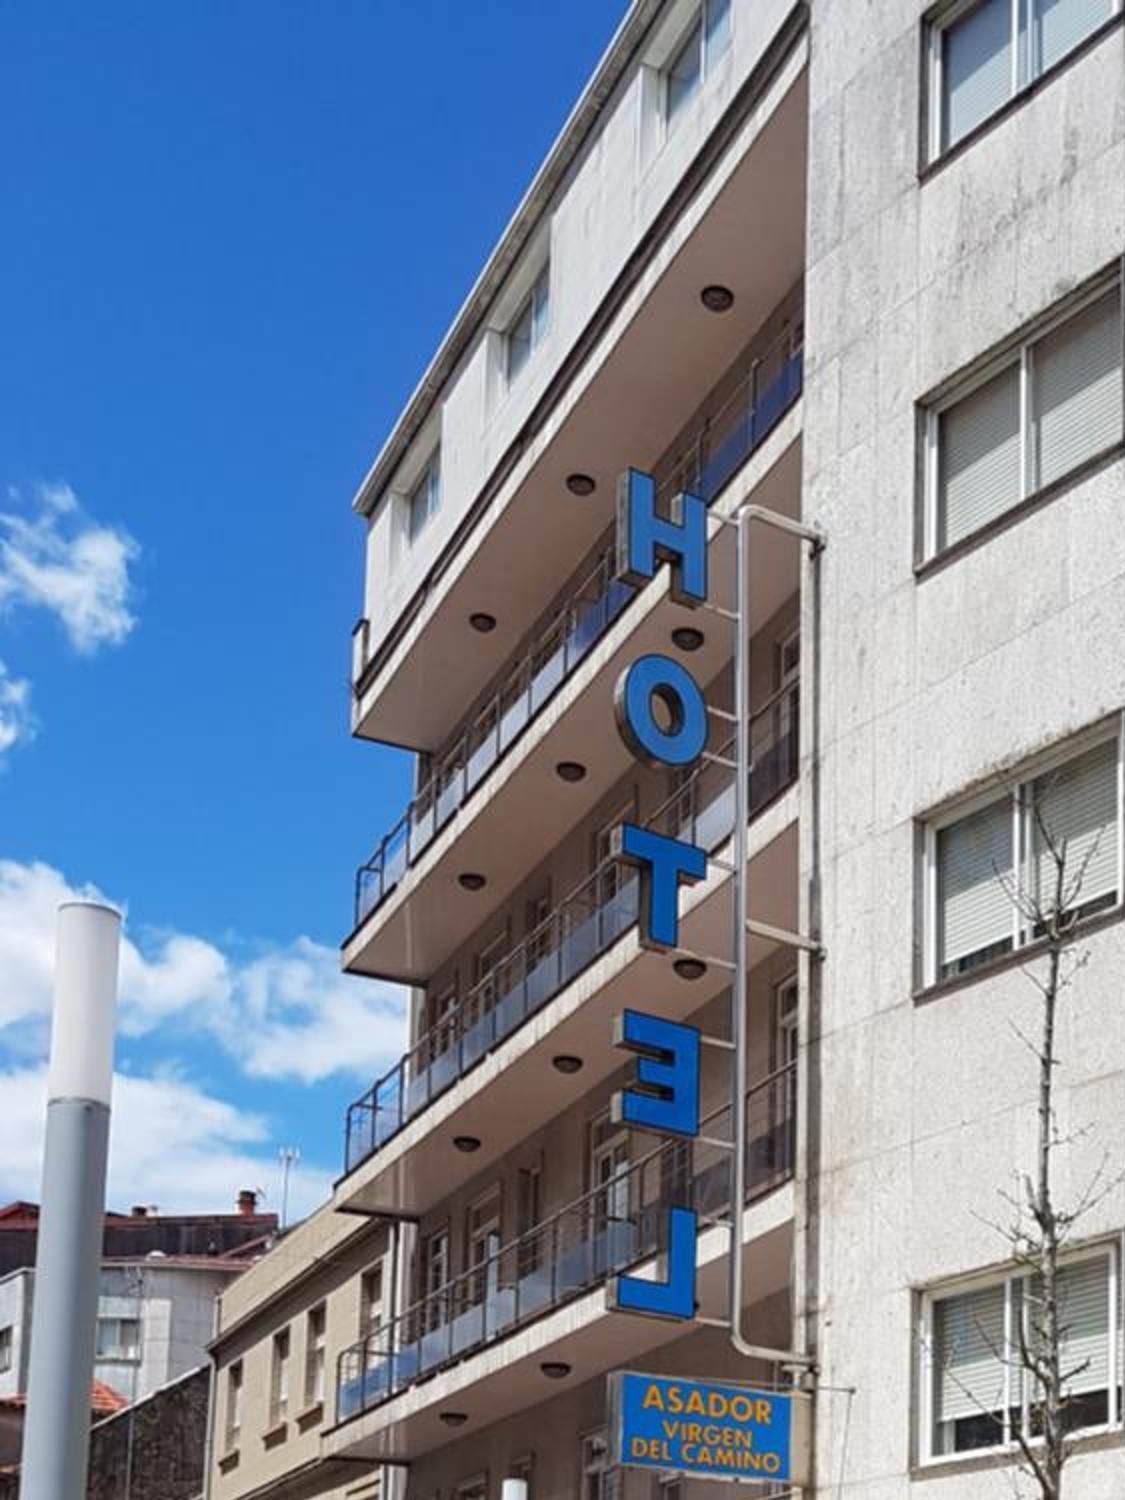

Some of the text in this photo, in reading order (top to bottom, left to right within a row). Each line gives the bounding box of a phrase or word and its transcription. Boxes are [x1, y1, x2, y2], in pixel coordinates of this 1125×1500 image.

[642, 1384, 773, 1425] ASADOR
[662, 1419, 754, 1448] VIRGEN
[631, 1437, 781, 1474] DEL CAMINO
